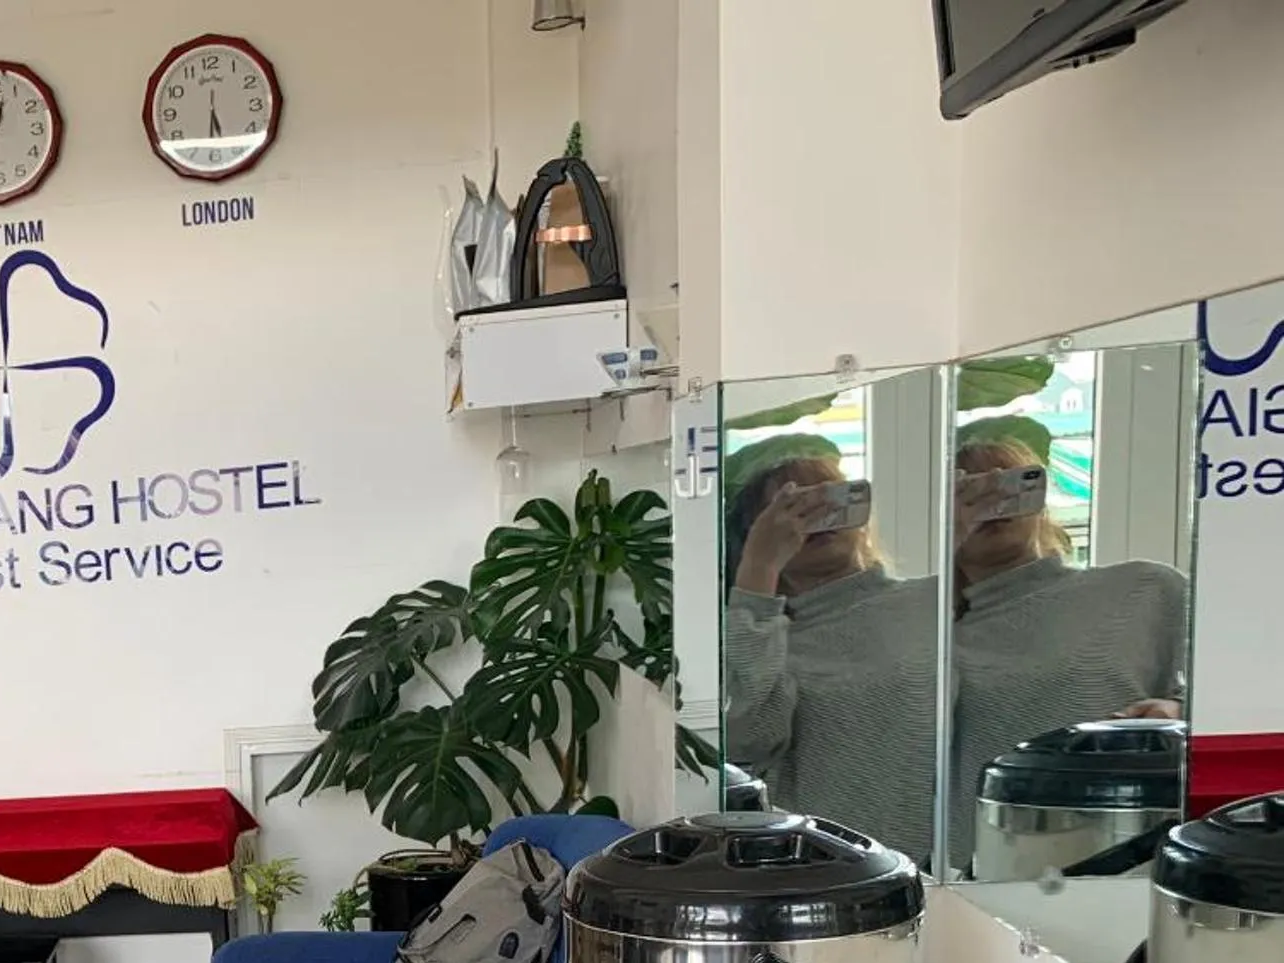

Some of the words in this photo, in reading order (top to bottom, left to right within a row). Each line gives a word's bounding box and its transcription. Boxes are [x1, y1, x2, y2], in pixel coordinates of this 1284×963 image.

[202, 56, 219, 70] 12
[184, 65, 195, 79] 11
[244, 75, 257, 89] 2
[168, 85, 184, 99] 10
[25, 100, 37, 114] 2
[249, 97, 263, 112] 3
[163, 107, 177, 121] 9
[30, 122, 44, 136] 3
[245, 121, 256, 133] 4
[28, 144, 39, 158] 4
[209, 149, 222, 162] 6
[182, 196, 254, 227] LONDON
[111, 460, 322, 524] HOSTEL
[38, 538, 223, 586] Service
